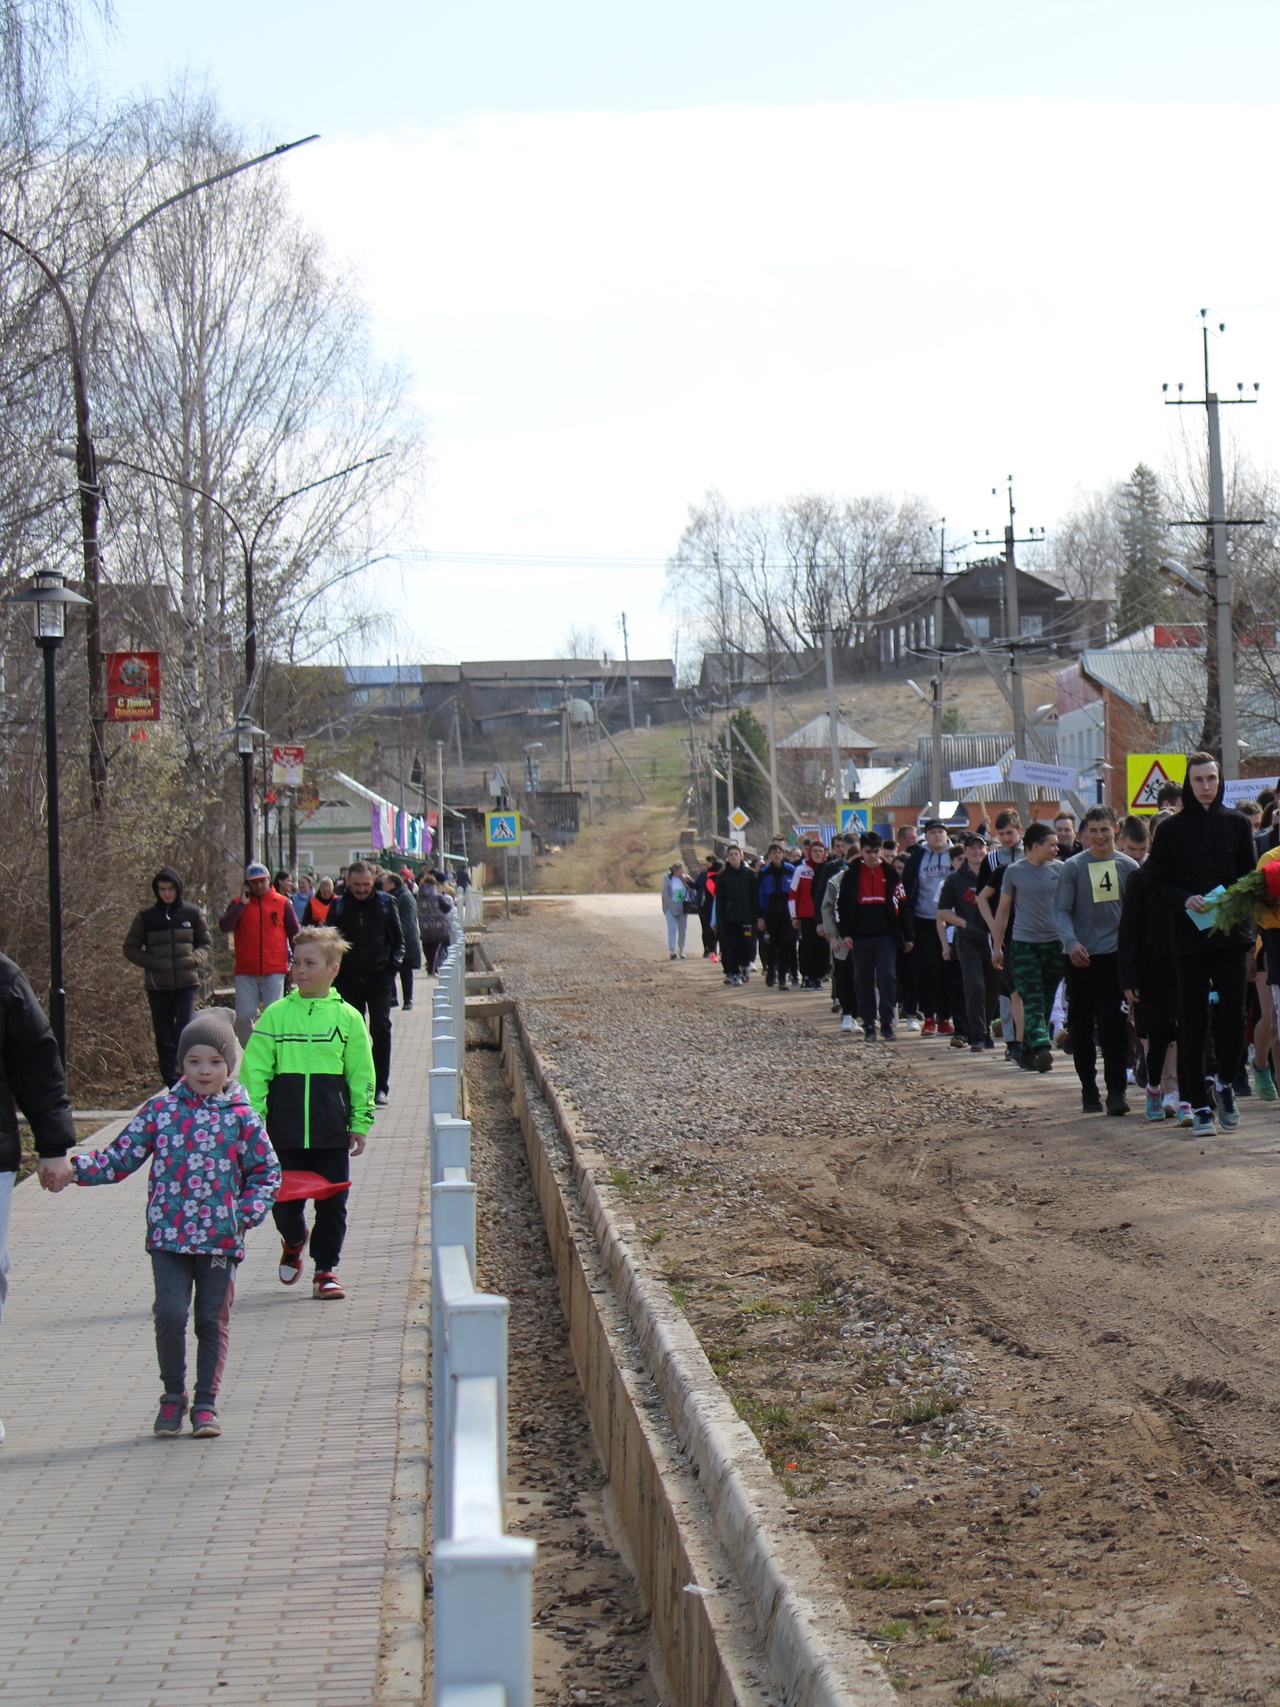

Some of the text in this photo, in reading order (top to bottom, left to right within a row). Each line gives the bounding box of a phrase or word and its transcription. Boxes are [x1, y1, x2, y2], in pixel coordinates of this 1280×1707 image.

[118, 698, 124, 708] С
[1022, 763, 1069, 777] Архангельская
[1025, 772, 1061, 783] территория
[1100, 871, 1112, 892] 4
